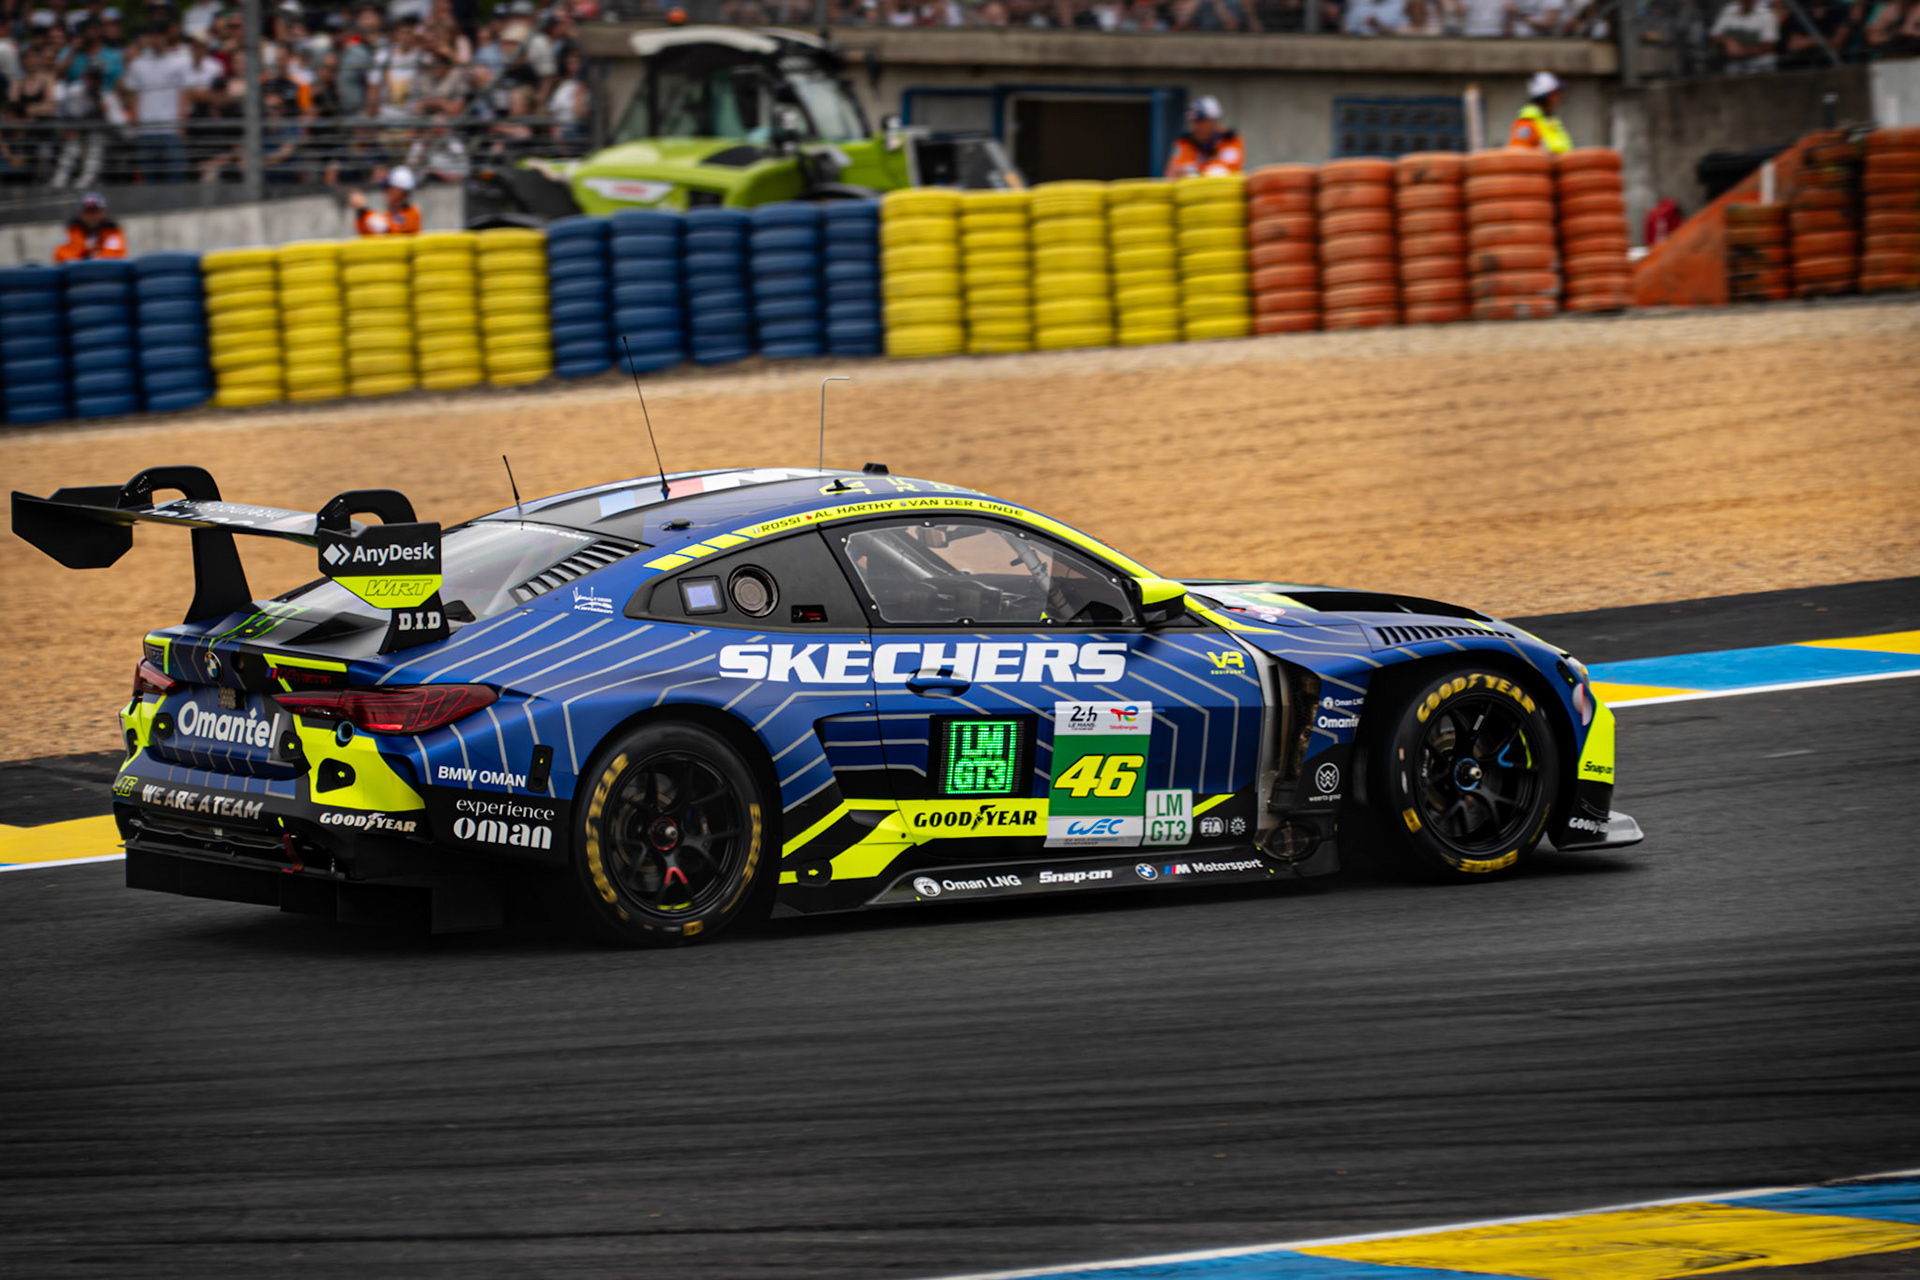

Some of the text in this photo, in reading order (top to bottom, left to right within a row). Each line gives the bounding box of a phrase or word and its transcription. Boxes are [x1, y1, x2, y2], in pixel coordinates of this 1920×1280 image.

[761, 499, 1024, 532] ROSSI AL HARTHY VAN DER LINDE
[352, 542, 435, 567] AnyDesk
[364, 579, 433, 596] WRT
[398, 612, 441, 631] D.I.D
[719, 642, 1128, 684] SKECHERS
[1207, 651, 1245, 669] VR
[1417, 673, 1537, 723] GOODYEAR
[177, 700, 280, 749] Omantel
[961, 723, 1005, 756] LM
[438, 766, 526, 788] BMW OMAN
[953, 760, 1007, 790] GT3
[1053, 753, 1145, 798] 46
[142, 783, 265, 820] WE ARE A TEAM
[456, 799, 555, 821] experience
[1156, 793, 1183, 817] LM
[319, 812, 417, 832] GOODYEAR
[914, 804, 1038, 831] GOODYEAR
[1067, 818, 1124, 836] WEC
[1200, 820, 1222, 834] FIA
[453, 817, 553, 850] oman
[1151, 820, 1187, 842] GT3
[1039, 869, 1113, 883] Snap-on
[1191, 859, 1264, 874] Motorsport
[942, 878, 987, 892] Oman
[986, 874, 1022, 889] LNG
